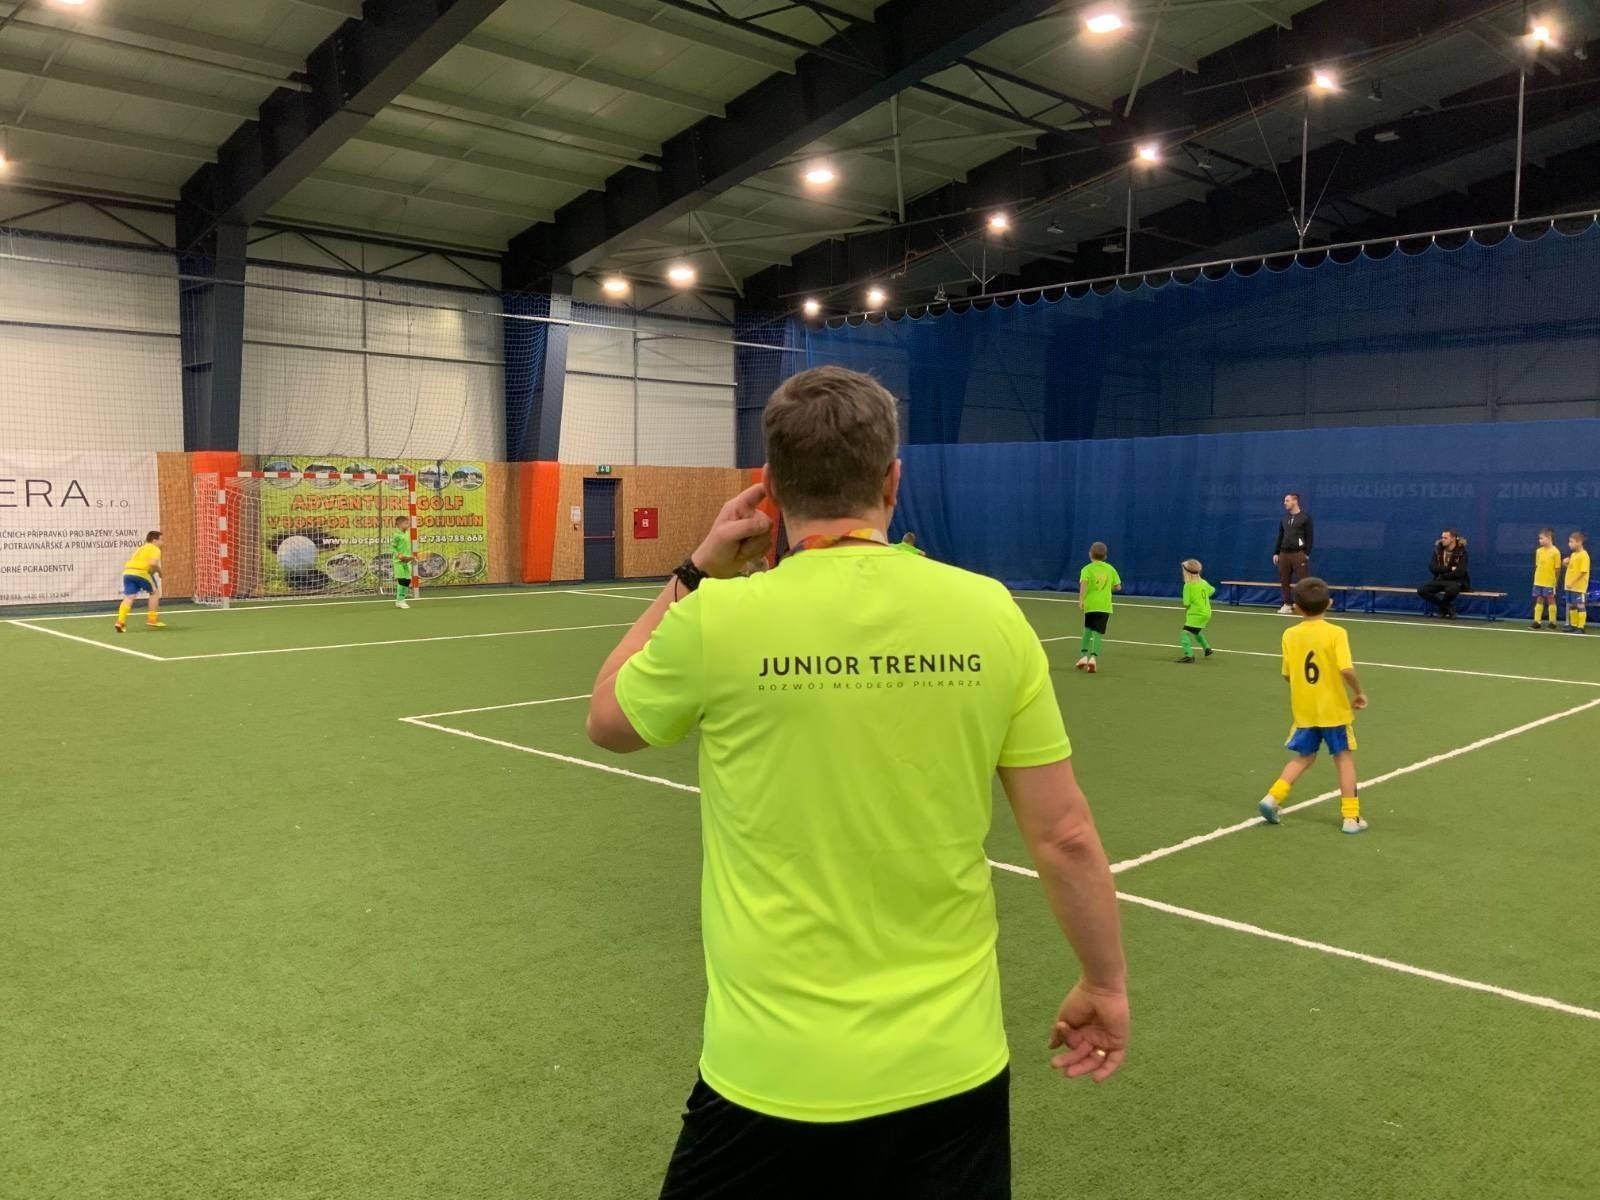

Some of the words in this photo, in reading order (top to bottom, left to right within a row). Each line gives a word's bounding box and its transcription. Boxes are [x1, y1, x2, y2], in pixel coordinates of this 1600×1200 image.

[1407, 482, 1475, 498] STEZKA
[1497, 477, 1568, 498] ZIMNÍ
[416, 495, 464, 511] GOLF
[267, 515, 280, 529] V
[282, 515, 350, 529] BOSPOR
[416, 513, 484, 527] BOHUMÍN
[69, 530, 84, 538] PRO
[429, 535, 448, 544] 734
[759, 656, 860, 677] JUNIOR
[869, 654, 982, 675] TRENING
[1304, 650, 1320, 684] 6
[758, 682, 824, 692] ROZWÓJ
[833, 681, 904, 690] MŁODEGO
[913, 680, 982, 688] PIŁKARZA
